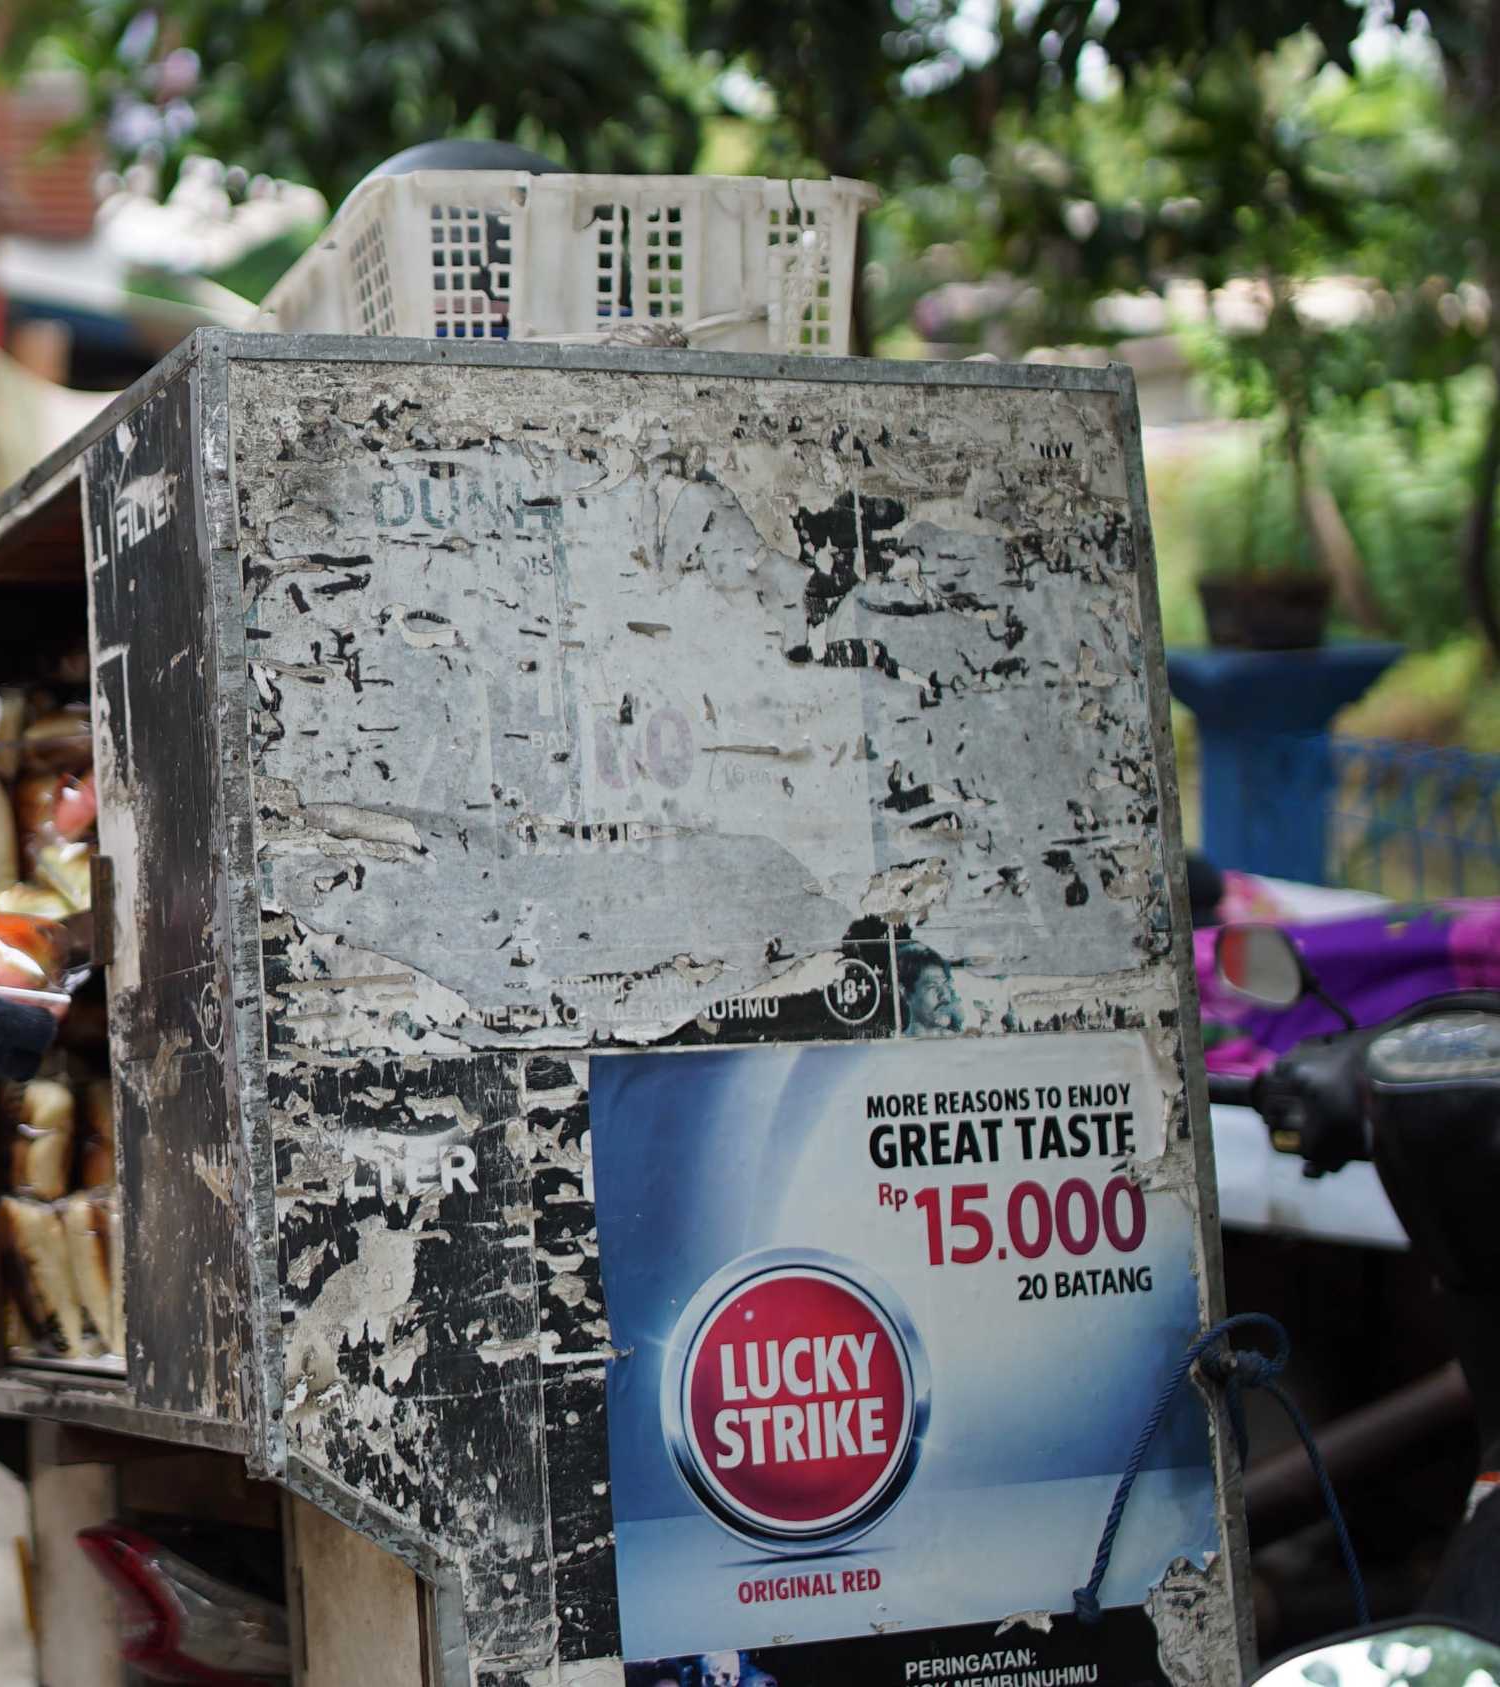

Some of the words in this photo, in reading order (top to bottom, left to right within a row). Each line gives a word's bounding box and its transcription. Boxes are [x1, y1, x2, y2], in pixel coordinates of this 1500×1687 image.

[115, 474, 179, 554] FILTER
[833, 978, 872, 1005] 18+
[866, 1092, 929, 1119] MORE
[934, 1086, 1031, 1115] REASONS
[1035, 1084, 1062, 1109] TO
[1068, 1083, 1132, 1108] ENJOY
[869, 1117, 1004, 1169] GREAT
[1014, 1111, 1136, 1161] TASTE
[877, 1182, 909, 1212] Rp
[913, 1174, 1148, 1267] 15.000
[1017, 1272, 1048, 1301] 20
[1054, 1265, 1153, 1299] BATANG
[719, 1331, 878, 1402] LUCKY
[713, 1397, 888, 1470] STRIKE
[737, 1570, 837, 1605] ORIGINAL
[842, 1567, 882, 1593] RED
[904, 1647, 1038, 1681] PERINGATAN:
